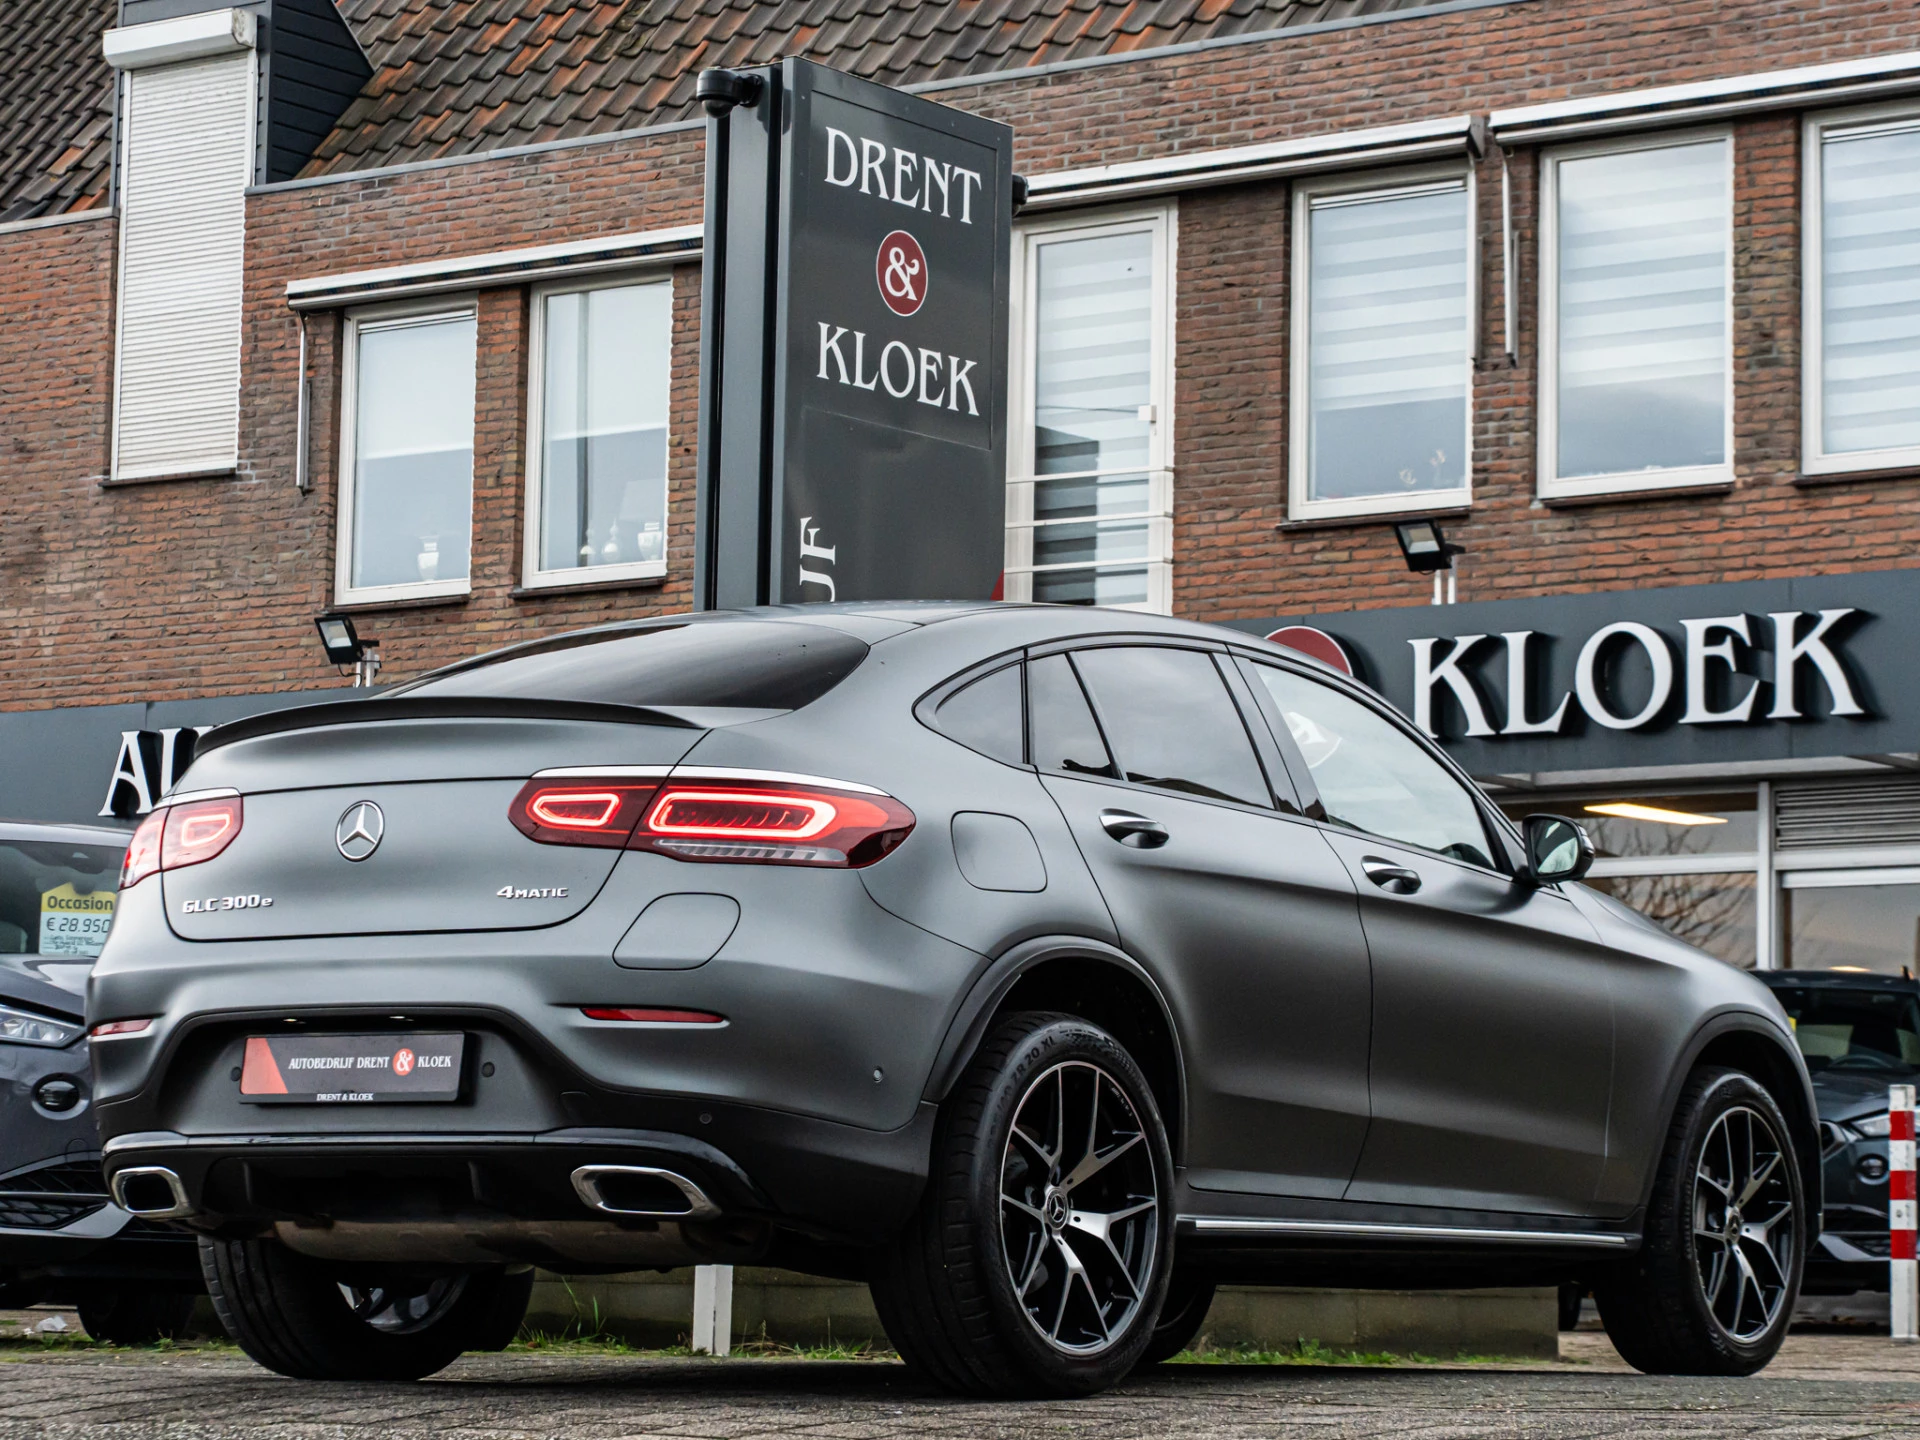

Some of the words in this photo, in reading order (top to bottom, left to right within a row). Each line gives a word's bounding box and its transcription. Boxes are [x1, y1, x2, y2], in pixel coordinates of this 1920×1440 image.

[824, 126, 982, 224] DRENT
[884, 247, 920, 301] &
[816, 321, 979, 416] KLOEK
[1407, 608, 1865, 739] KLOEK
[47, 895, 114, 911] Occasion
[182, 899, 219, 913] GLC
[288, 1057, 354, 1069] AUTOBEDRIJF
[356, 1056, 389, 1069] DRENT
[396, 1051, 413, 1072] &
[417, 1055, 452, 1068] KLOEK
[316, 1093, 341, 1101] DRENT
[348, 1093, 374, 1101] KLOEK
